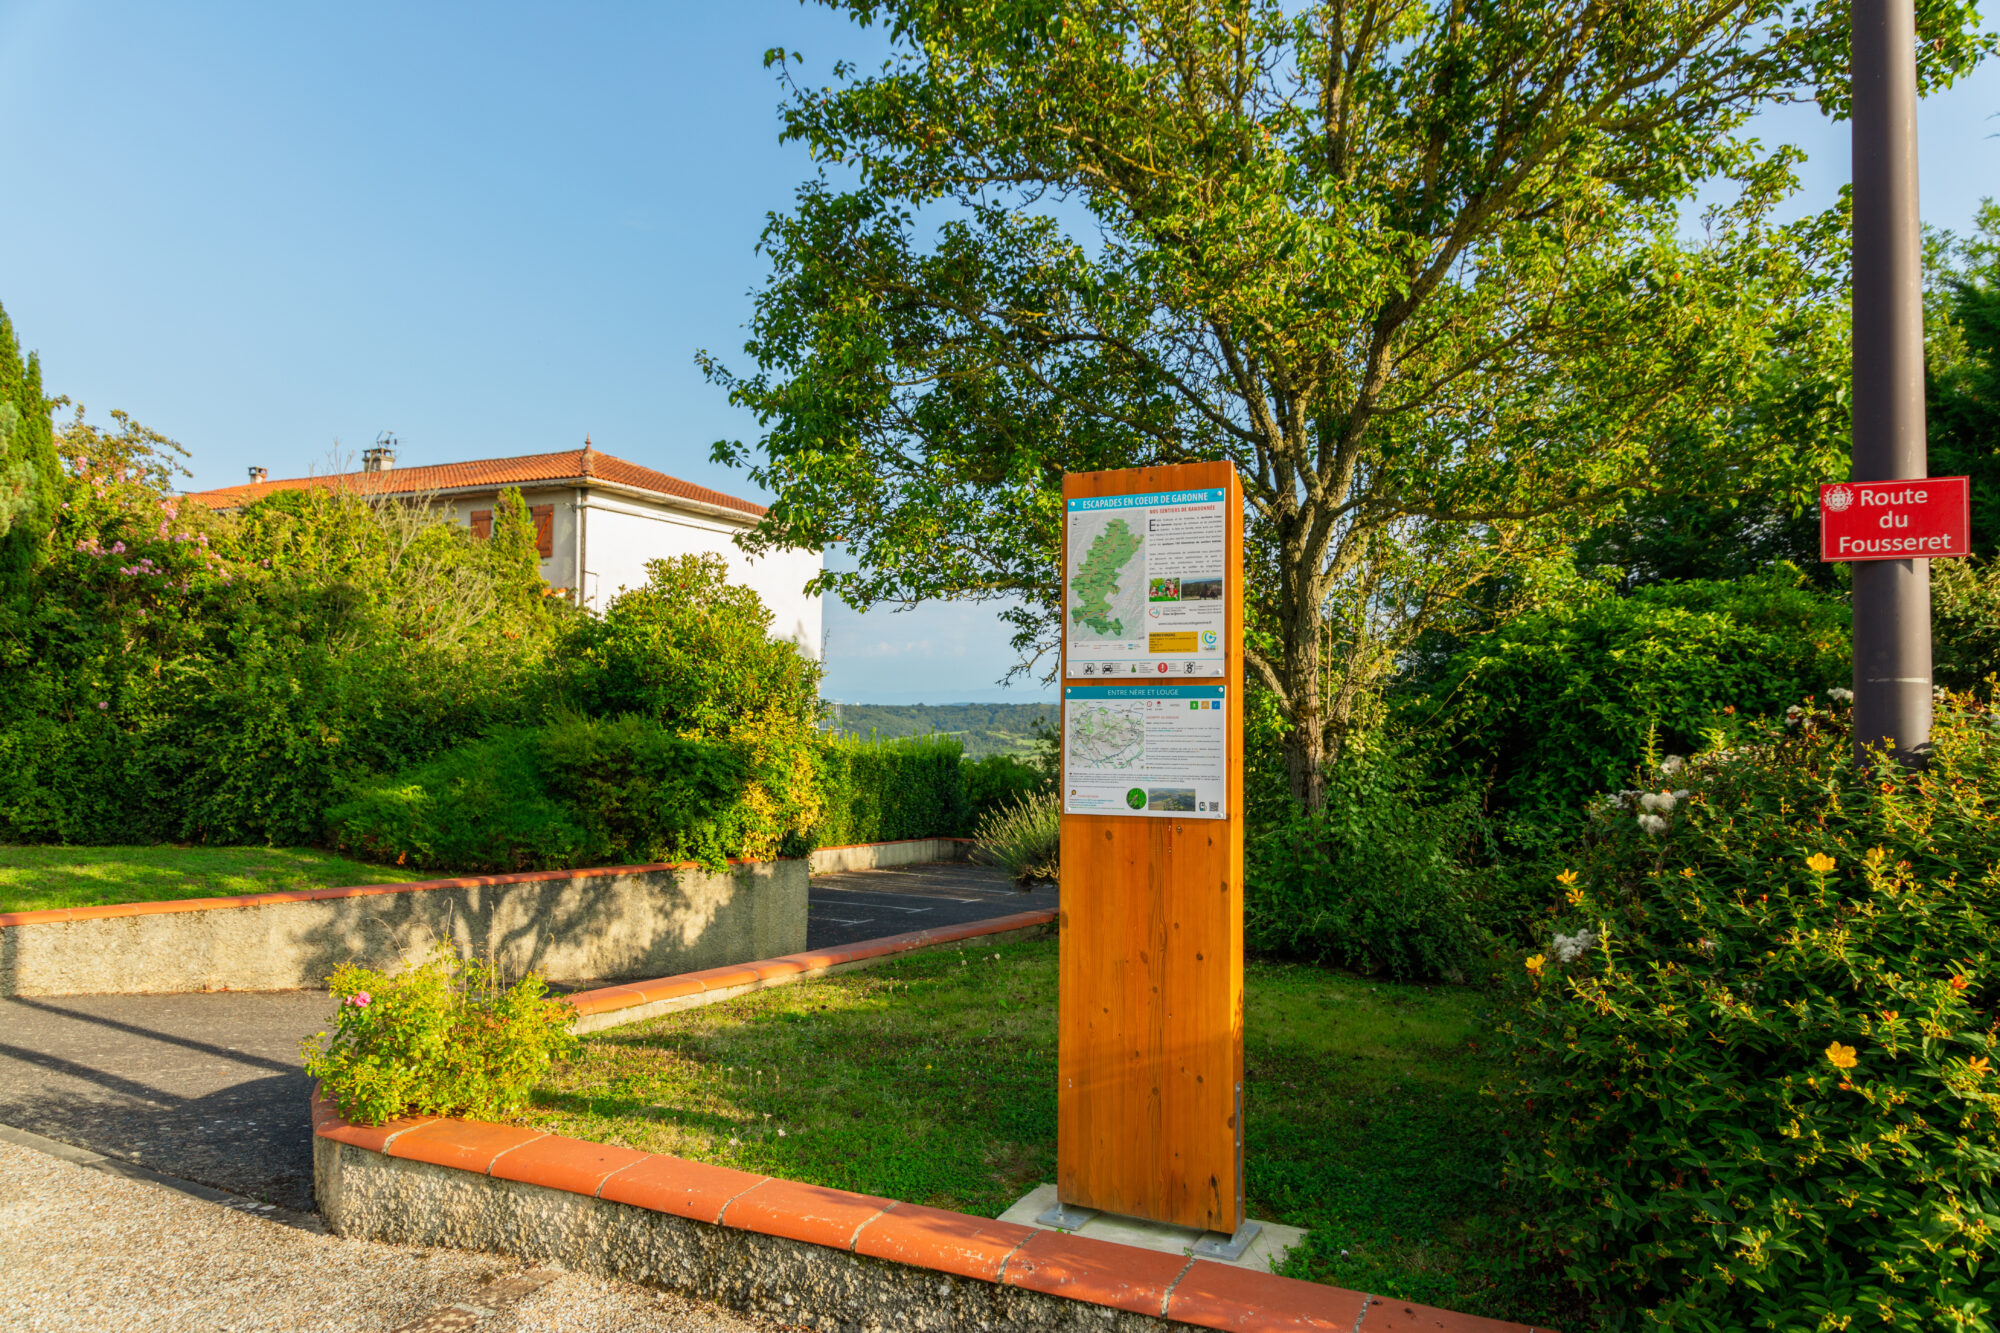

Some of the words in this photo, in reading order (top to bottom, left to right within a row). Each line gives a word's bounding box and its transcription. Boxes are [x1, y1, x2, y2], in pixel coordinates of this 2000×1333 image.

[1083, 498, 1122, 509] ESCAPADES
[1124, 497, 1134, 506] EN
[1135, 495, 1159, 505] COEUR
[1160, 494, 1170, 504] DE
[1171, 492, 1209, 503] GARONNE
[1860, 488, 1928, 507] Route
[1879, 510, 1908, 528] du
[1839, 533, 1952, 553] Fousseret
[1156, 688, 1179, 696] LOUGE
